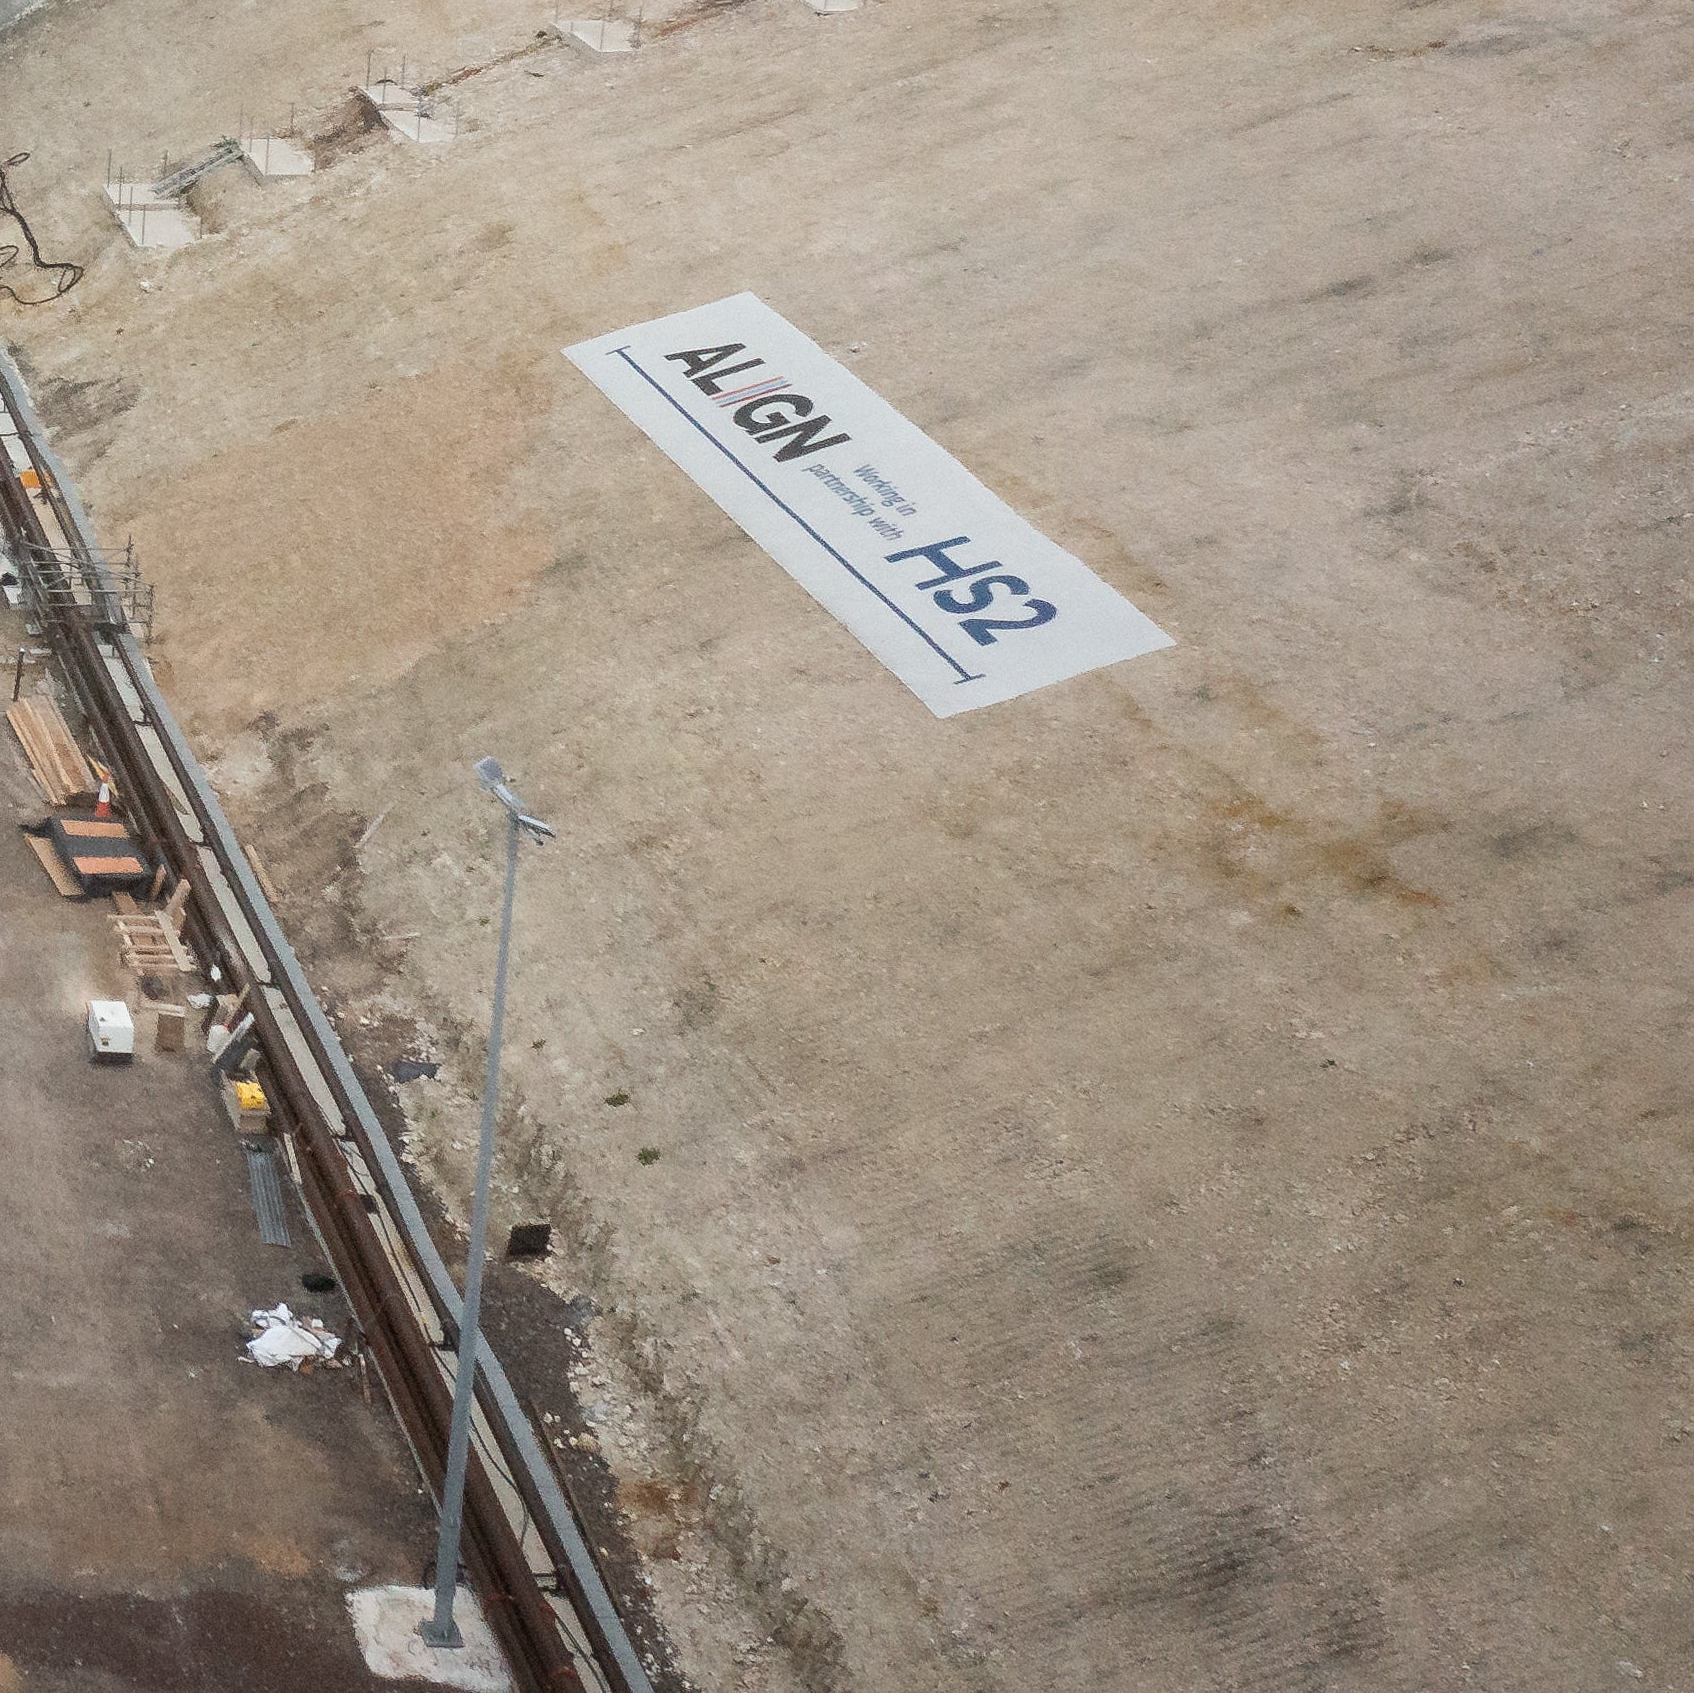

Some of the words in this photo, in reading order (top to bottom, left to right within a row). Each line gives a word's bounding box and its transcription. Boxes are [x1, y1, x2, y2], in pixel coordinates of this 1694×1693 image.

[664, 343, 852, 463] ALIGN
[801, 463, 875, 517] partnership
[868, 516, 905, 541] with
[853, 463, 906, 508] Working
[895, 502, 917, 517] in
[884, 535, 1057, 647] HS2
